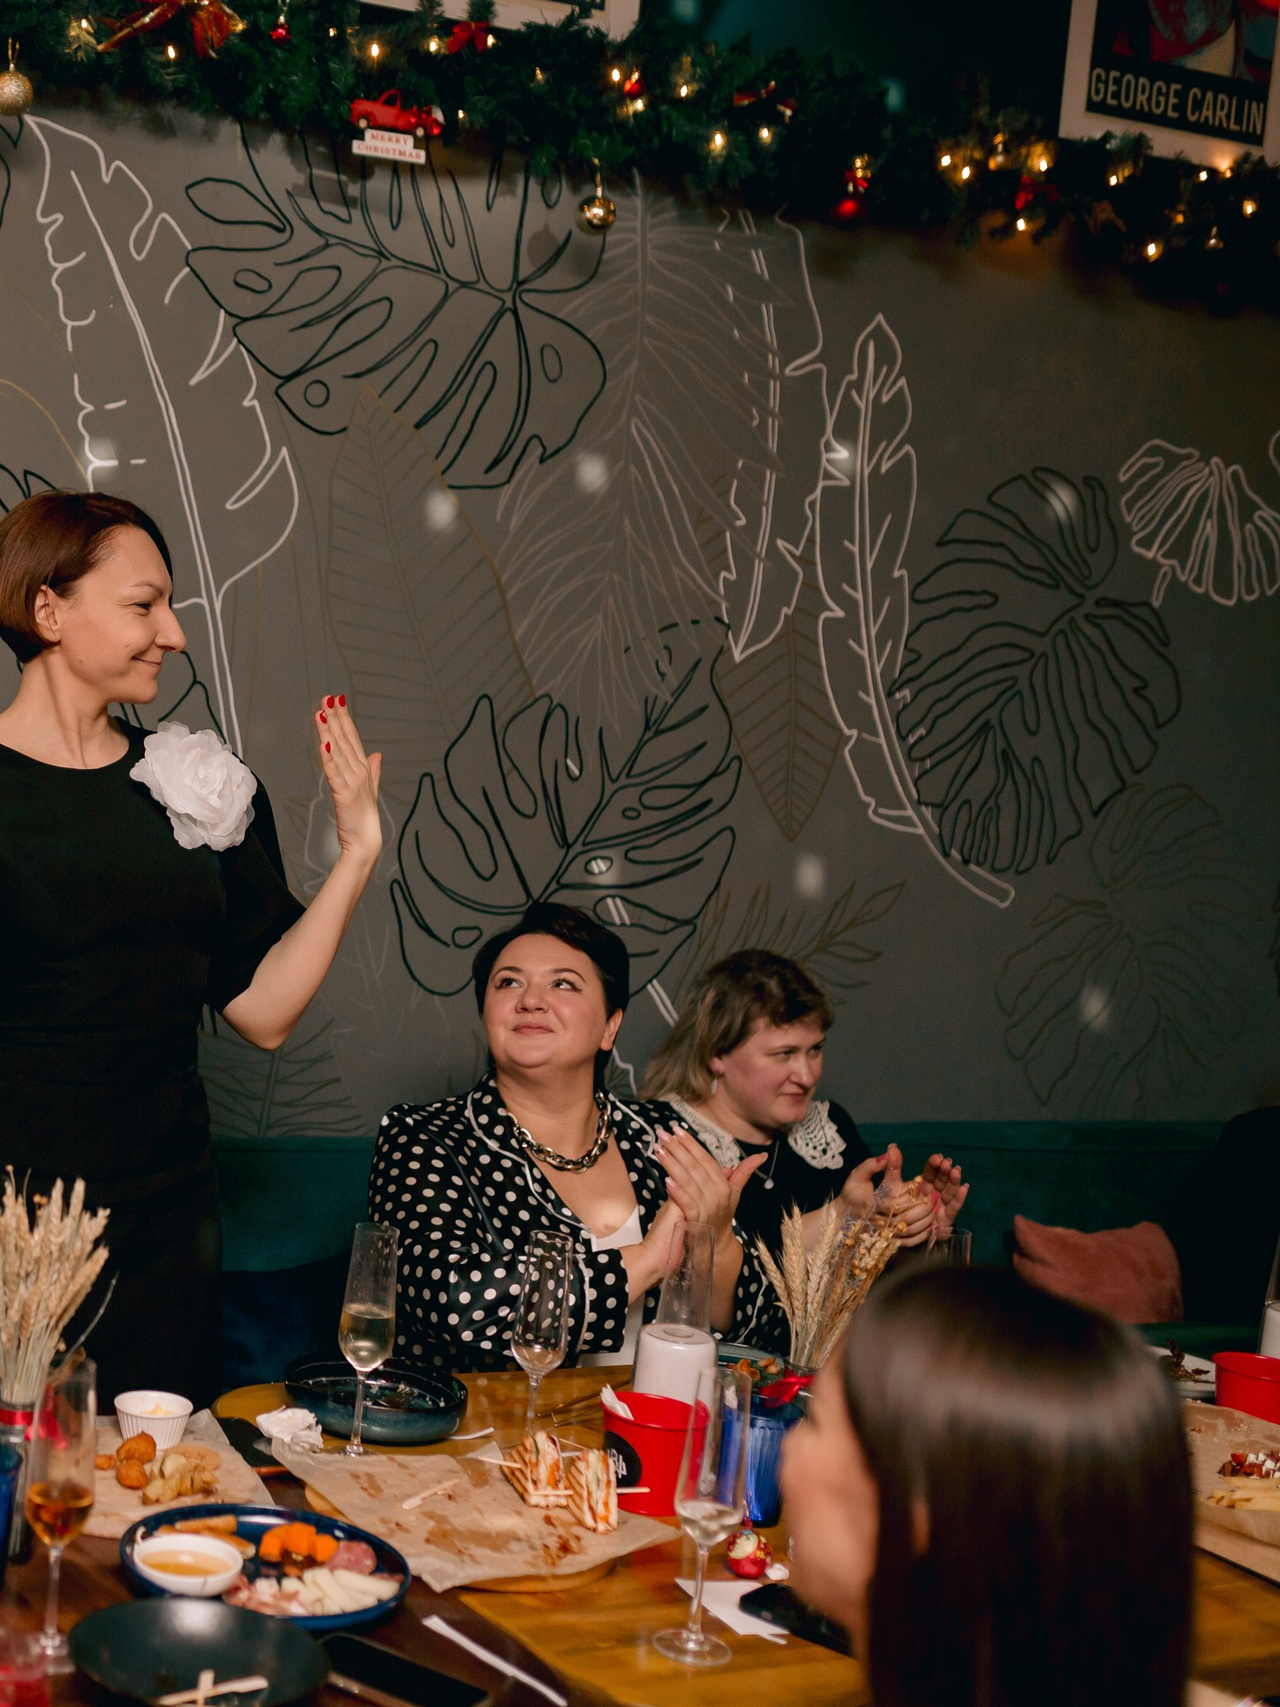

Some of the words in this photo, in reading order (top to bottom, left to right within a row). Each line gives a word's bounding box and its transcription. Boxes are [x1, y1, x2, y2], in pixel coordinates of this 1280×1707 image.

[1090, 67, 1183, 119] GEORGE
[1186, 87, 1265, 136] CARLIN
[370, 132, 409, 145] MERRY
[357, 143, 421, 160] CHRISTMAS
